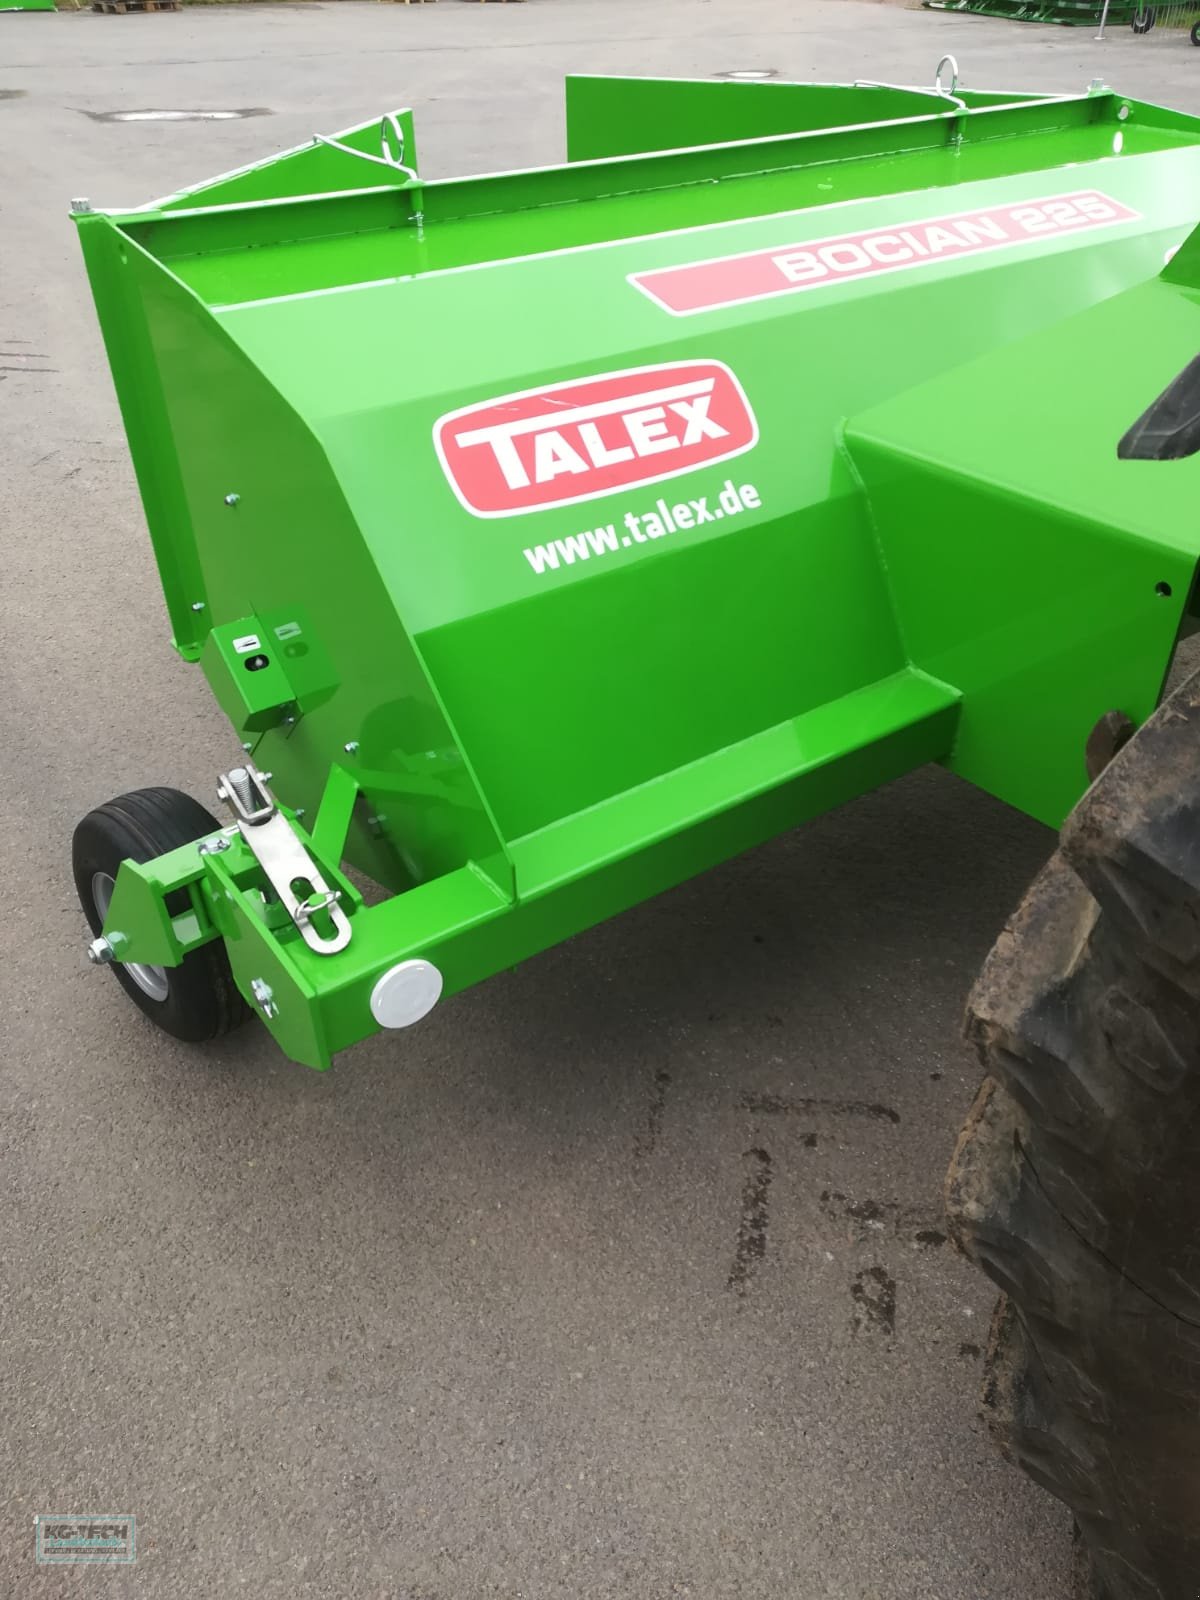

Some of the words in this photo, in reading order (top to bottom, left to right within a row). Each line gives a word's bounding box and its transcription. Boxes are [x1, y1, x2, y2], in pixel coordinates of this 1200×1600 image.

[772, 216, 1008, 283] BOCIAN
[1009, 196, 1118, 233] 225
[455, 377, 730, 490] TALEX
[523, 480, 762, 574] www.talex.de
